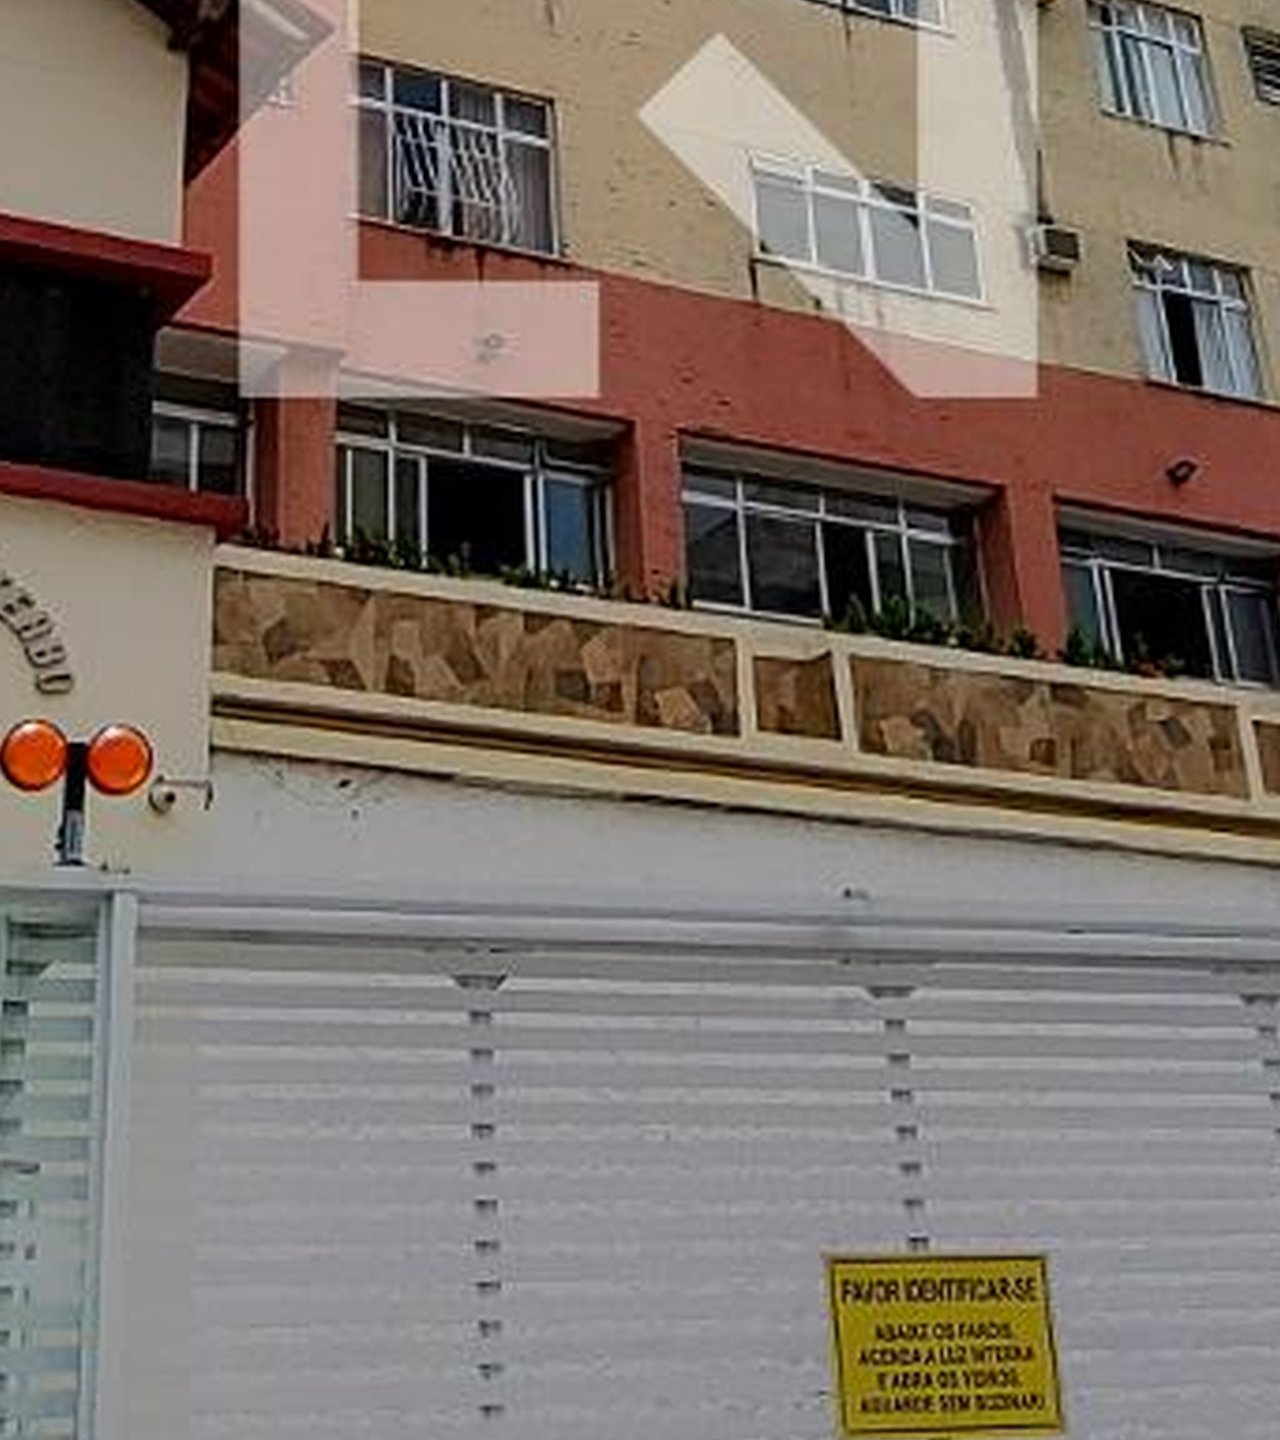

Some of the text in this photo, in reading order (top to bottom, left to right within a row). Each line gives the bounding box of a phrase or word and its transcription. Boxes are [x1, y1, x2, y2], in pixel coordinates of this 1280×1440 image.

[840, 1277, 1037, 1303] FAVOR IDENTIFICAR-SE
[931, 1323, 955, 1340] OS
[924, 1350, 936, 1366] A
[938, 1347, 967, 1365] LUZ
[877, 1374, 887, 1391] E
[937, 1372, 960, 1389] OS
[939, 1395, 971, 1412] SEM
